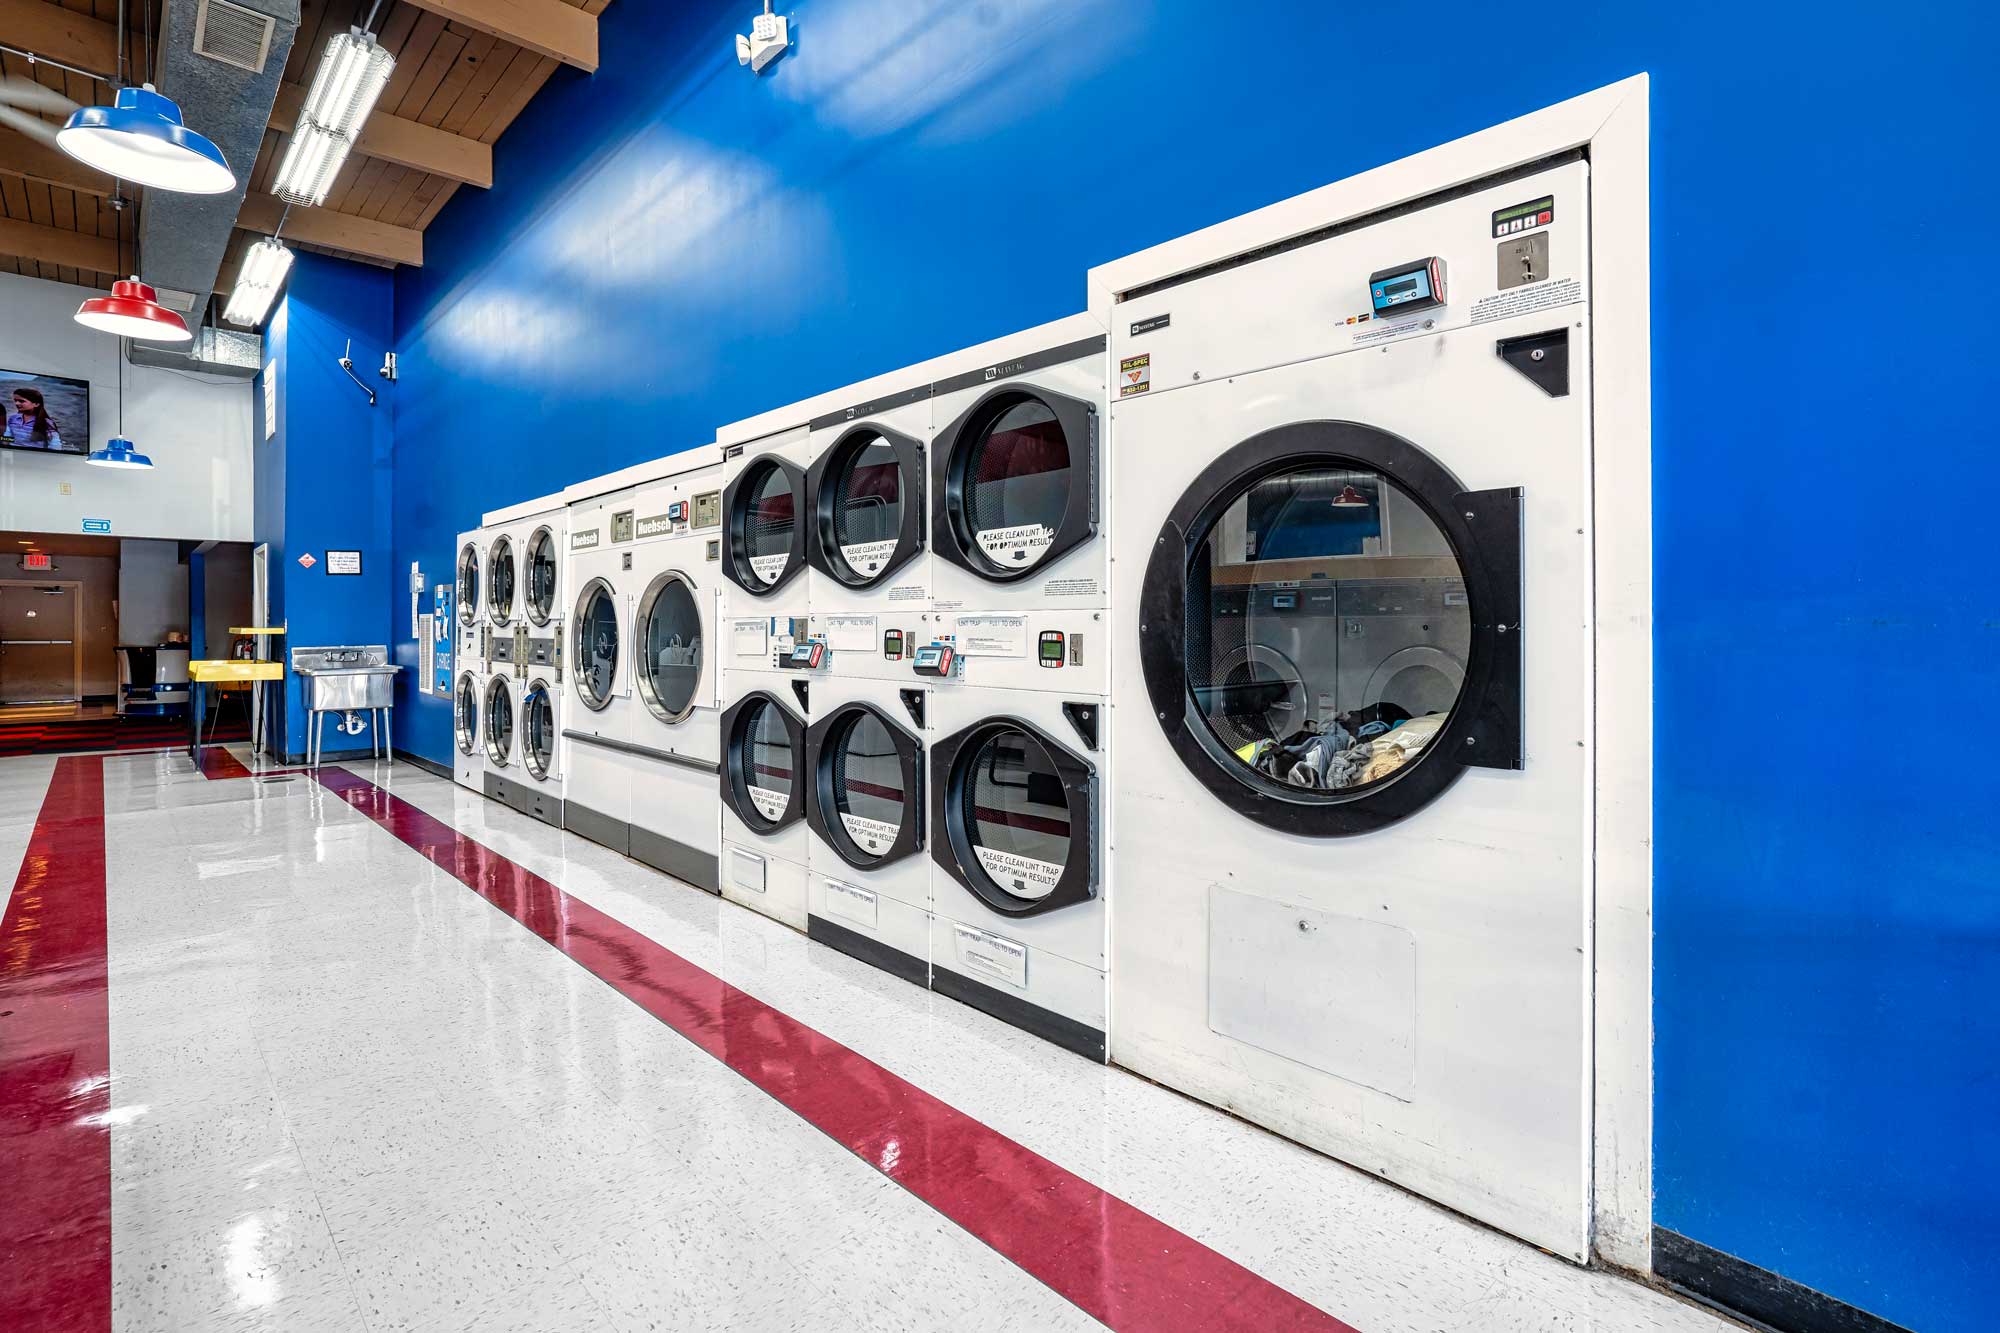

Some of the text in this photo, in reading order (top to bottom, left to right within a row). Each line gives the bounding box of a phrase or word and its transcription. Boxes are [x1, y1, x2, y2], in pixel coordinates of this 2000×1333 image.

[637, 517, 671, 535] Huebsch
[572, 532, 598, 547] Huebsch
[982, 532, 1004, 542] PLEASE
[1005, 530, 1025, 540] CLEAN
[1025, 528, 1039, 536] LINT
[846, 546, 862, 555] PLEASE
[862, 545, 877, 554] CLEAN
[876, 543, 887, 552] LINT
[985, 537, 1053, 551] FOR OPTIMUM RESULT
[28, 555, 48, 567] EXIT
[849, 555, 858, 563] FOR
[858, 554, 879, 562] OPTIMUM
[846, 817, 862, 826] PLEASE
[862, 820, 877, 830] CLEAN
[876, 823, 887, 832] LINT
[848, 825, 858, 833] FOR
[857, 828, 879, 839] OPTIMUM
[982, 851, 1059, 876] PLEASE CLEAN LINT TRAP
[985, 861, 1056, 886] FOR OPTIMUM RESULTS
